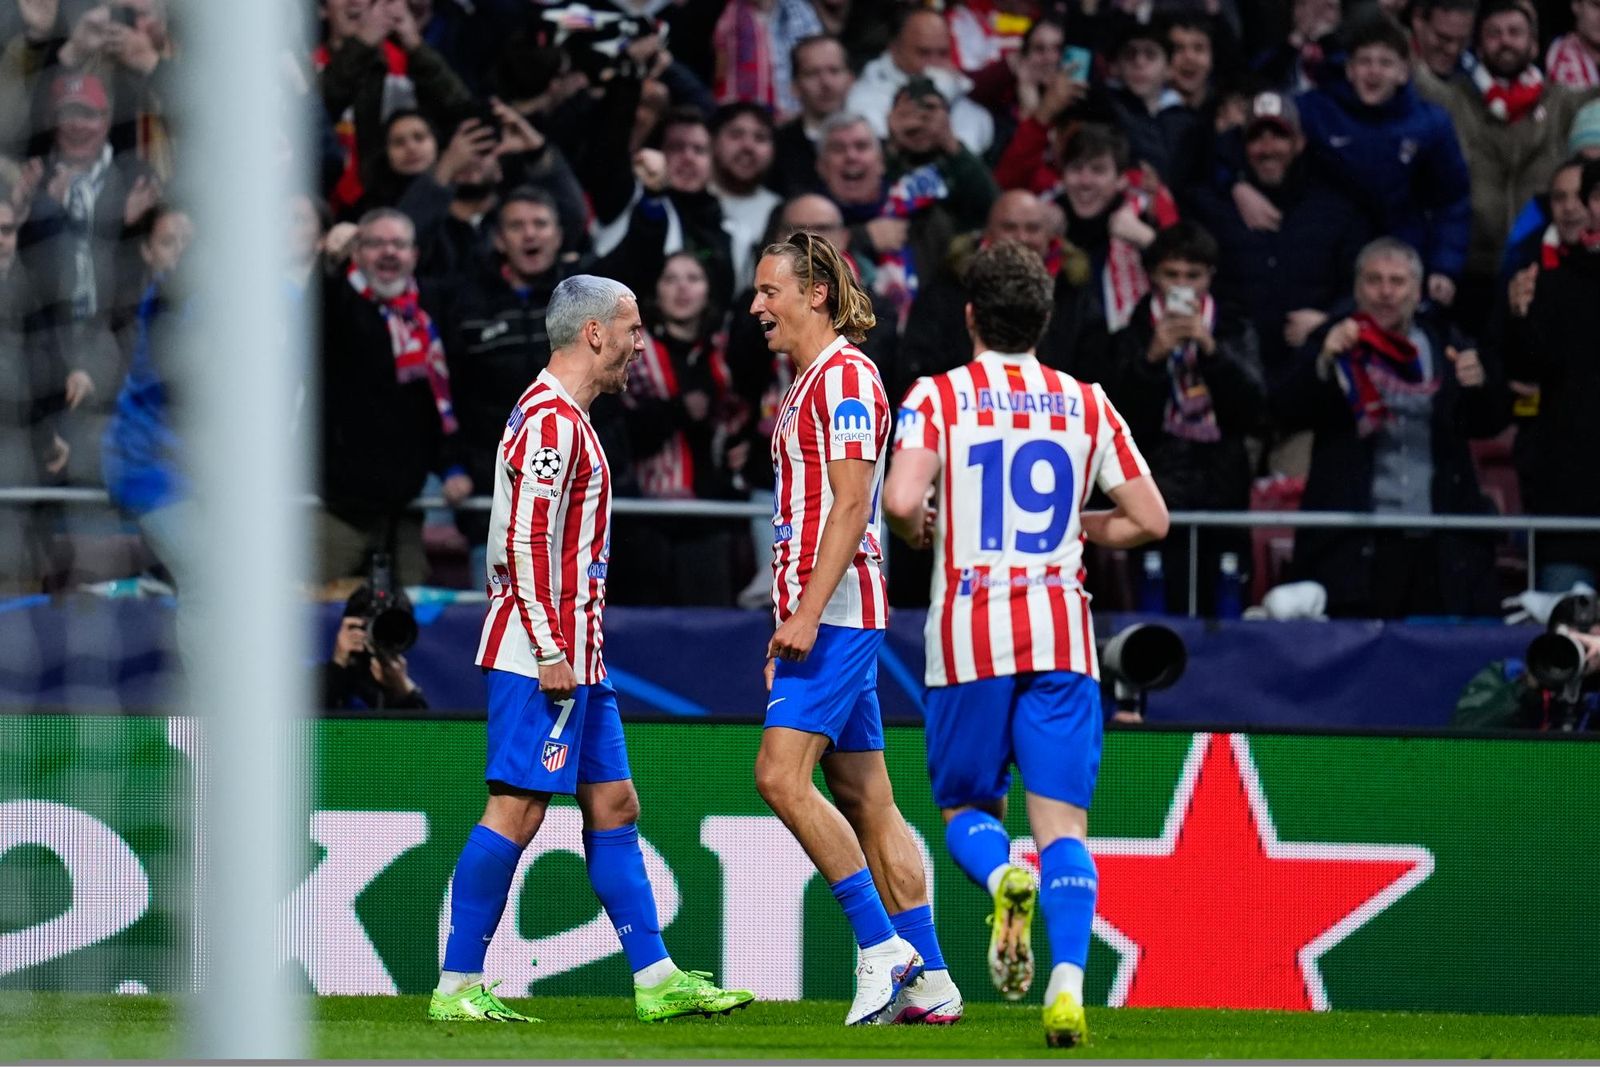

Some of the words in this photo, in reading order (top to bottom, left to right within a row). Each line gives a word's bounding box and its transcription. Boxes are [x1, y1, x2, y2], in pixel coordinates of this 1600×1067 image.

[959, 390, 1080, 417] J.ALVAREZ
[834, 431, 872, 442] kraken
[968, 438, 1075, 555] 19
[553, 698, 576, 740] 7
